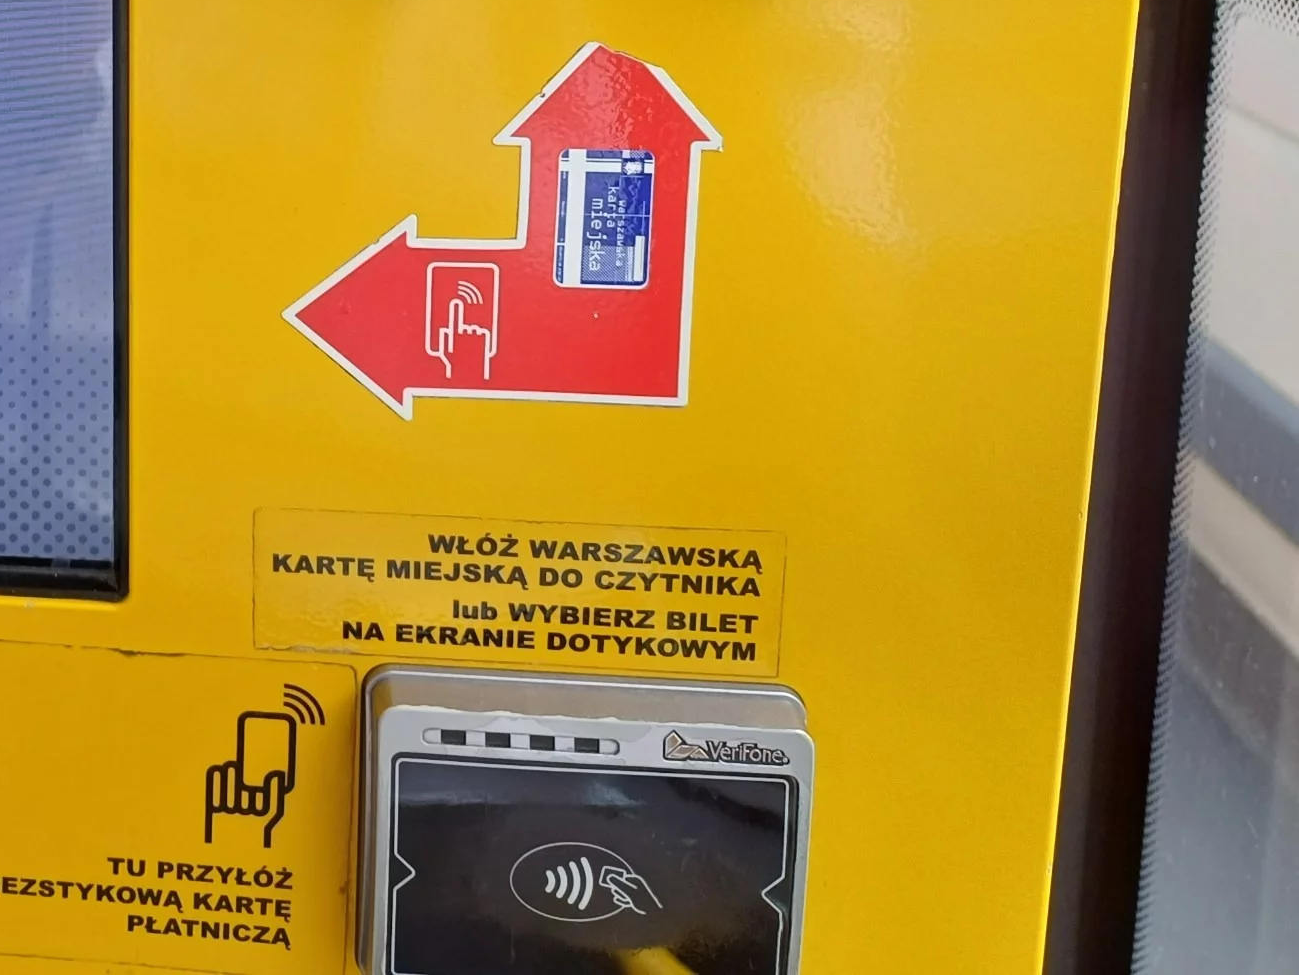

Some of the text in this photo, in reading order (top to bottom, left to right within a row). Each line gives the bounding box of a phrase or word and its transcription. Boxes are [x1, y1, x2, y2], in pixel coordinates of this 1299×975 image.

[606, 186, 620, 228] karta
[586, 198, 607, 271] miejska
[272, 552, 762, 598] KARTĘ MIEJSKĄ DO CZYTNIKA
[427, 533, 764, 575] WŁÓŻ WARSZAWSKĄ
[452, 599, 759, 635] lub WYBIERZ BILET
[341, 620, 757, 662] NA EKRANIE DOTYKOWYM
[107, 856, 293, 890] TU PRZYŁÓŻ
[193, 892, 292, 923] KARTĘ
[127, 914, 292, 951] PŁATNICZĄ
